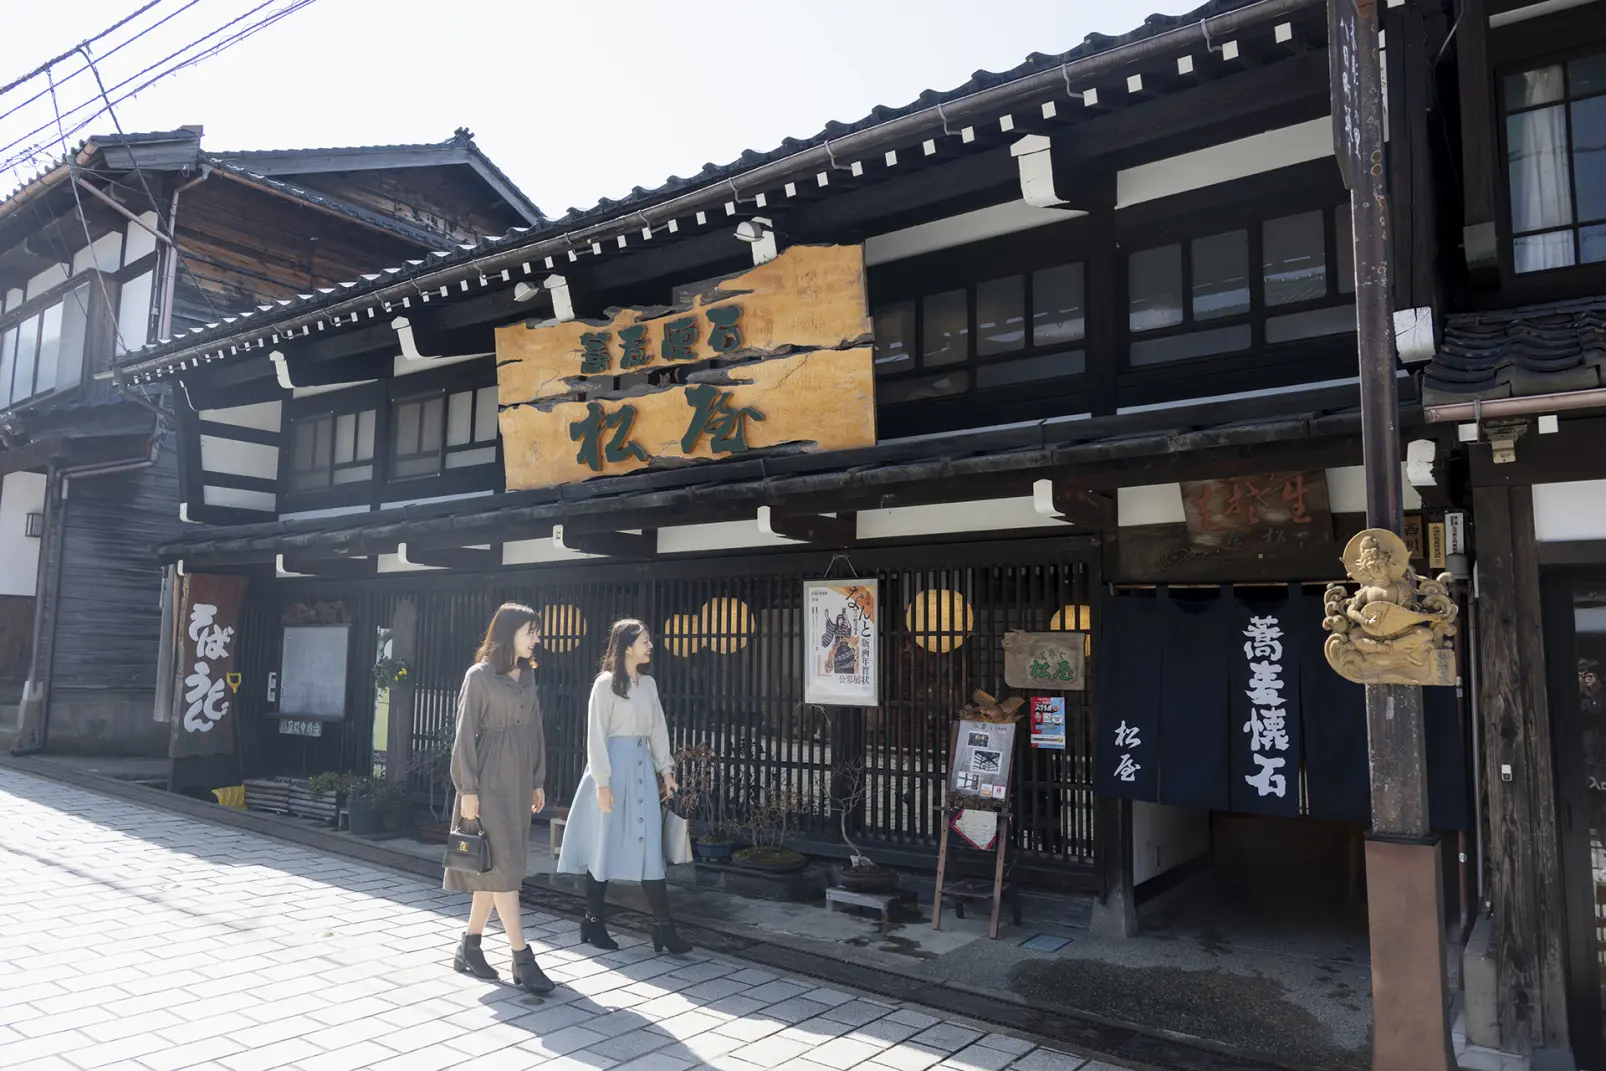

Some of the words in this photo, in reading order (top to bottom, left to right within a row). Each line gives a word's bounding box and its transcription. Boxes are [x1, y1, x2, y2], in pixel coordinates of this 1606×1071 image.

[569, 383, 766, 471] 松屋
[188, 603, 234, 660] そば
[184, 661, 230, 733] うどん
[1030, 659, 1073, 682] 松屋
[1242, 615, 1289, 798] 蕎麦懐石
[1113, 720, 1141, 782] 松屋
